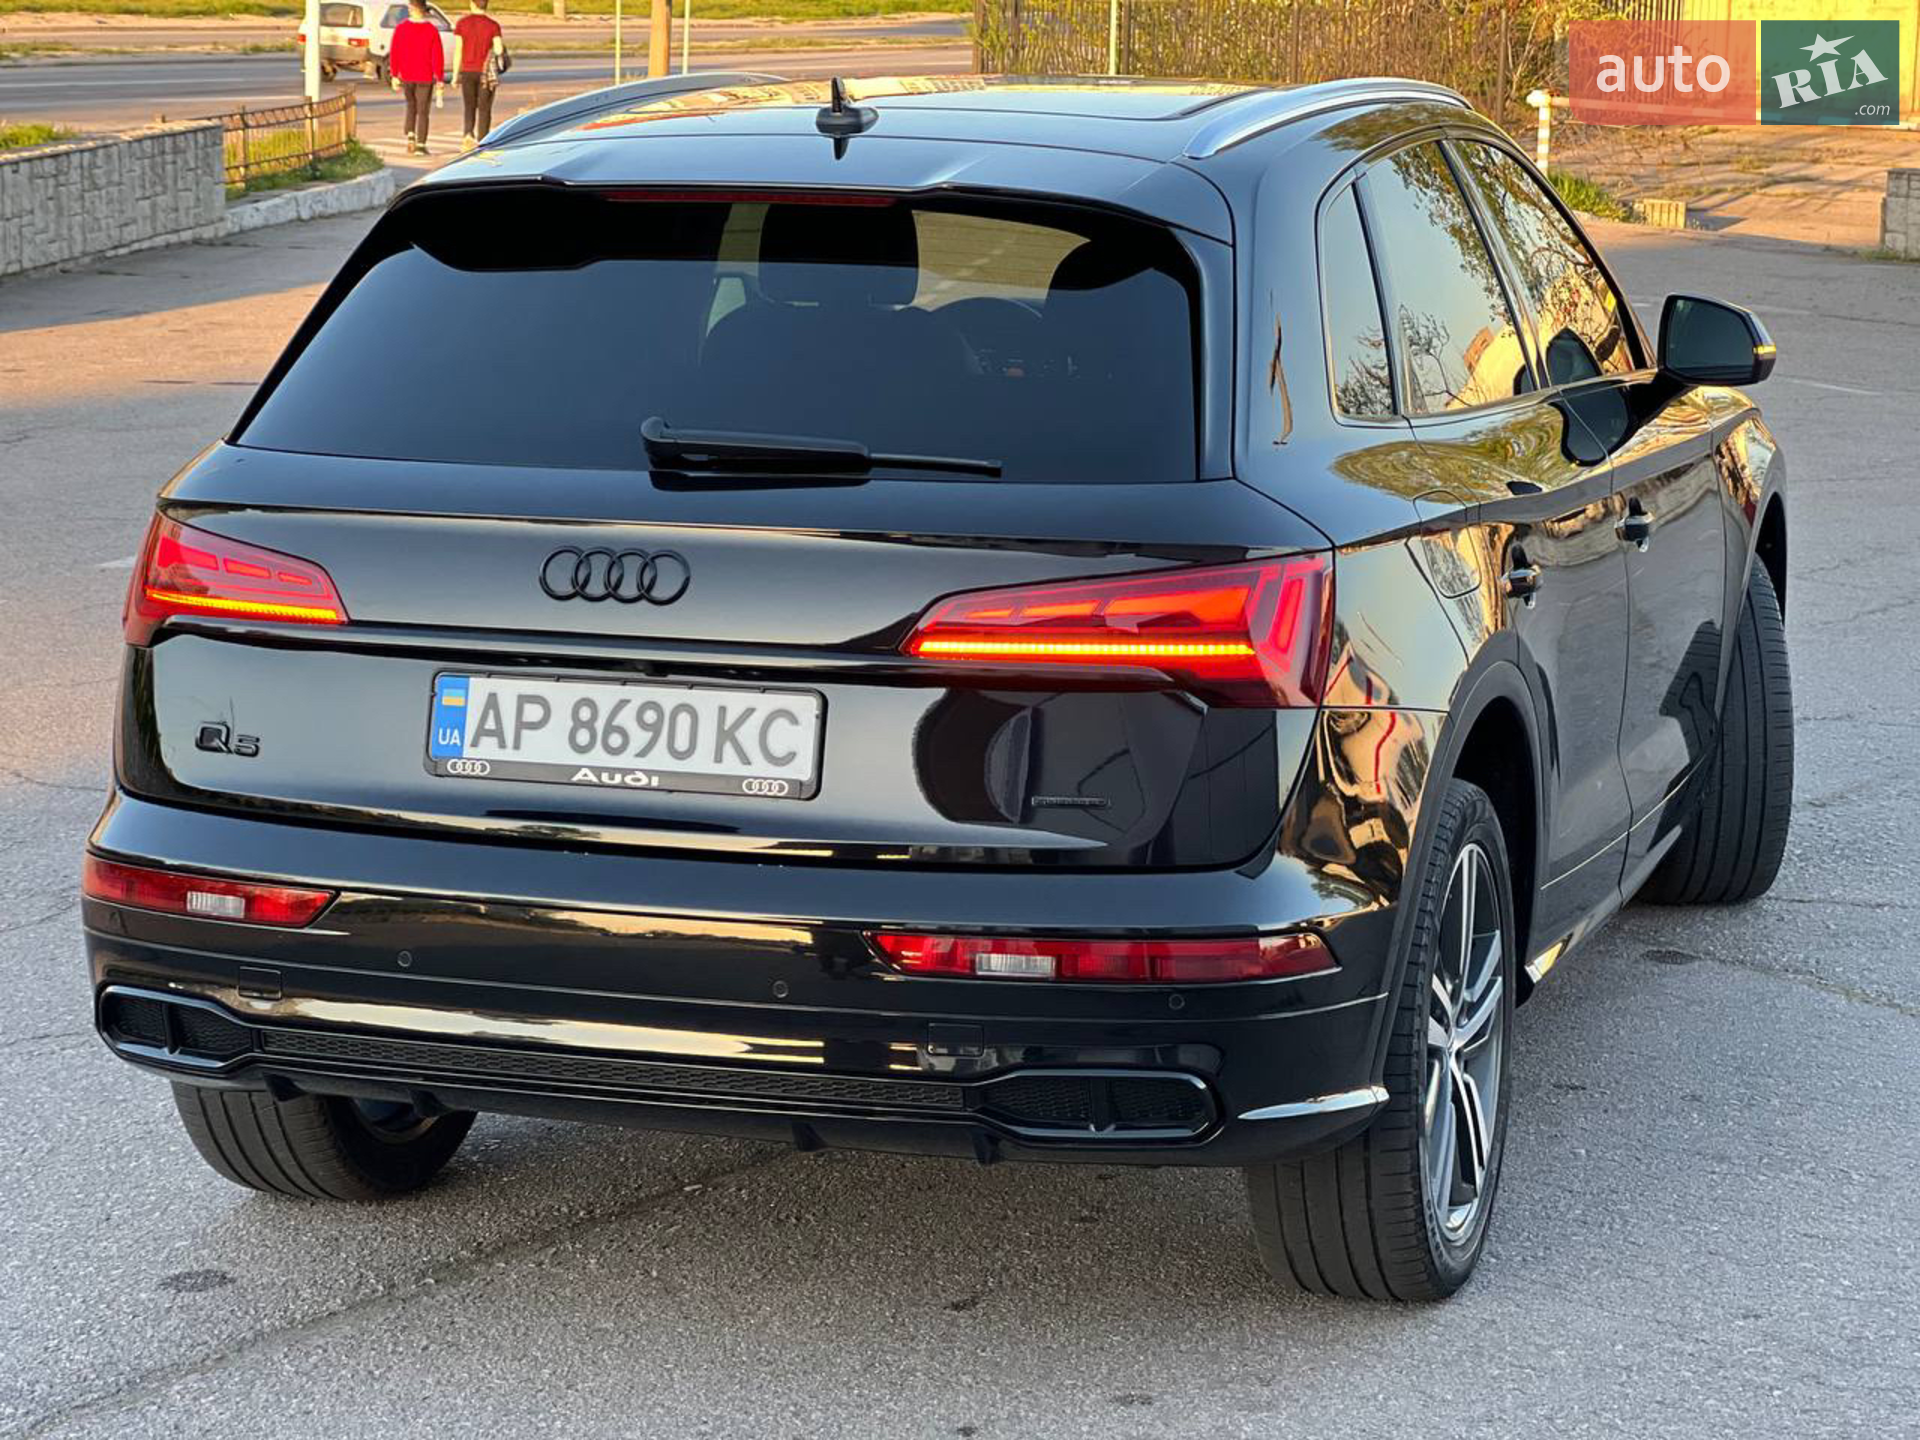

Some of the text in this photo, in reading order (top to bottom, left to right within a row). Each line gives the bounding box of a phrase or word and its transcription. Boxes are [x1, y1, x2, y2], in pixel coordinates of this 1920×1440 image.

[437, 728, 462, 747] UA
[470, 691, 801, 768] AP 8690 KC
[571, 767, 660, 788] Audi
